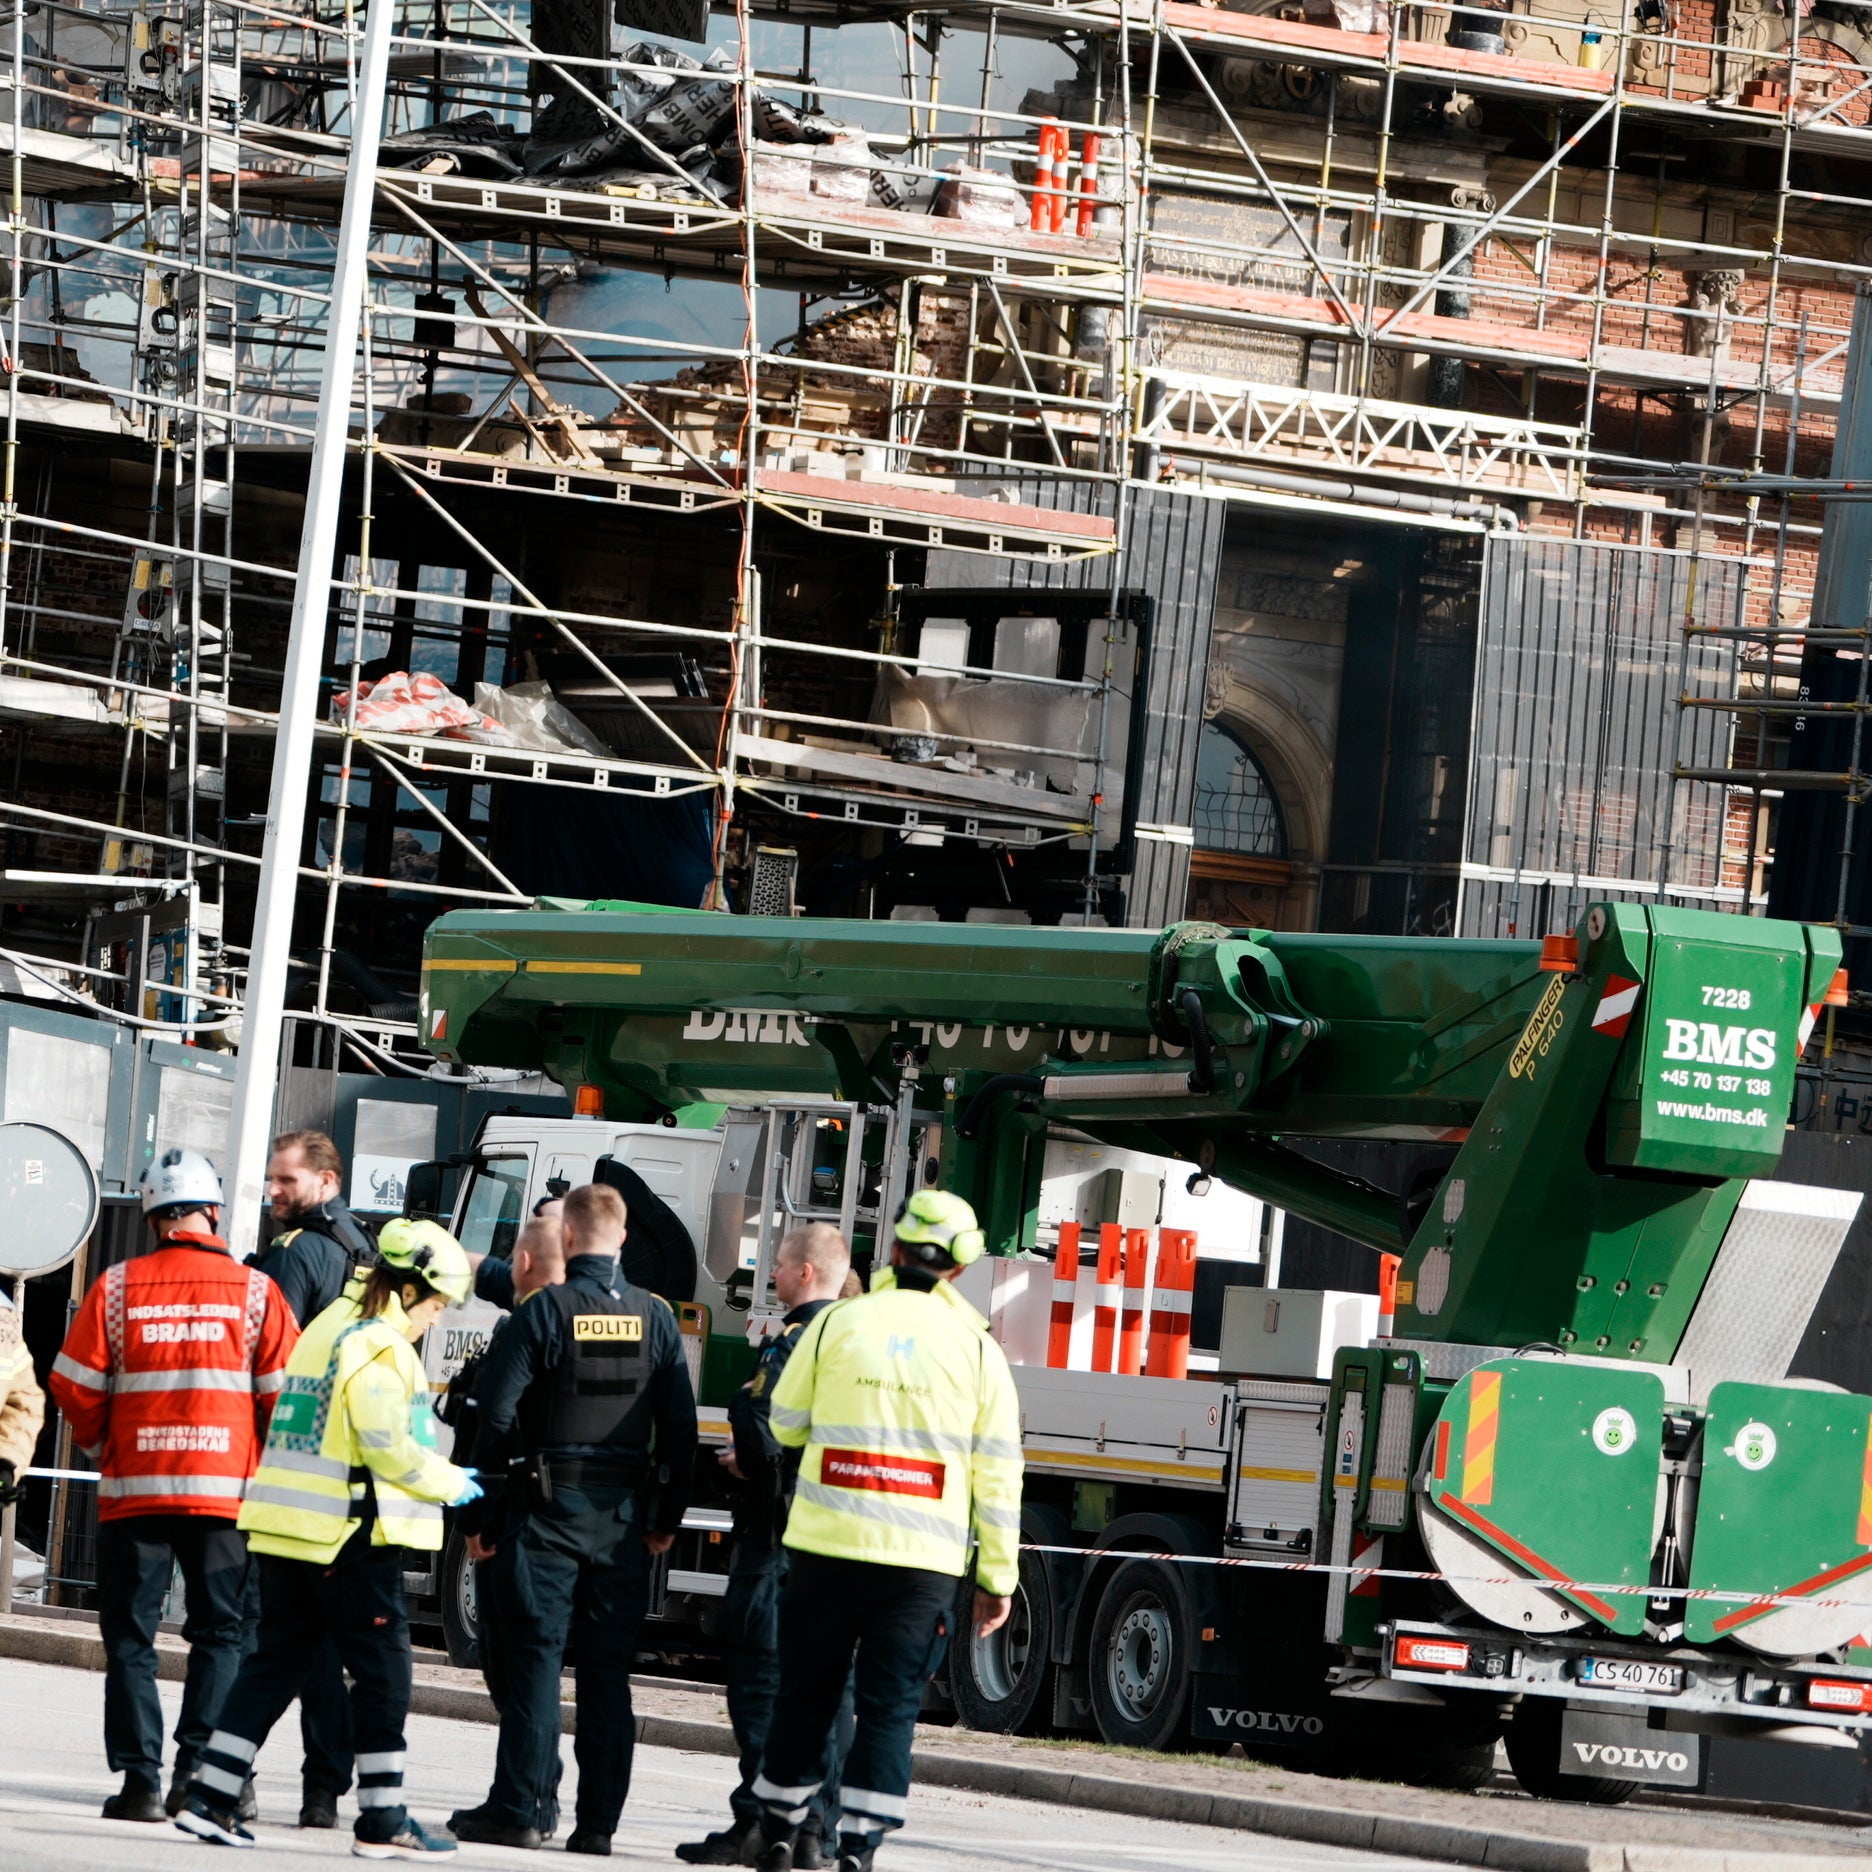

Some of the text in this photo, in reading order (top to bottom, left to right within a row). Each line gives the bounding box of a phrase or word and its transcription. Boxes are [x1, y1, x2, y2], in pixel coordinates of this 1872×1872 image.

[1701, 986, 1752, 1011] 7228
[1512, 979, 1563, 1073] PALFINGER
[1526, 1009, 1564, 1082] P 640
[1662, 1018, 1777, 1071] BMS
[1660, 1070, 1772, 1097] +45 70 137 138
[1657, 1100, 1769, 1128] www.bms.dk
[127, 1303, 242, 1320] INDSATSLEDER
[141, 1321, 226, 1344] BRAND
[577, 1320, 639, 1336] POLITI
[856, 1377, 932, 1398] AMBULANCE
[136, 1436, 231, 1453] BEREDSKAB
[829, 1461, 934, 1485] PARAMEDICINER
[1594, 1661, 1678, 1687] CS 40 761
[1207, 1706, 1325, 1736] VOLVO
[1572, 1741, 1689, 1772] VOLVO
